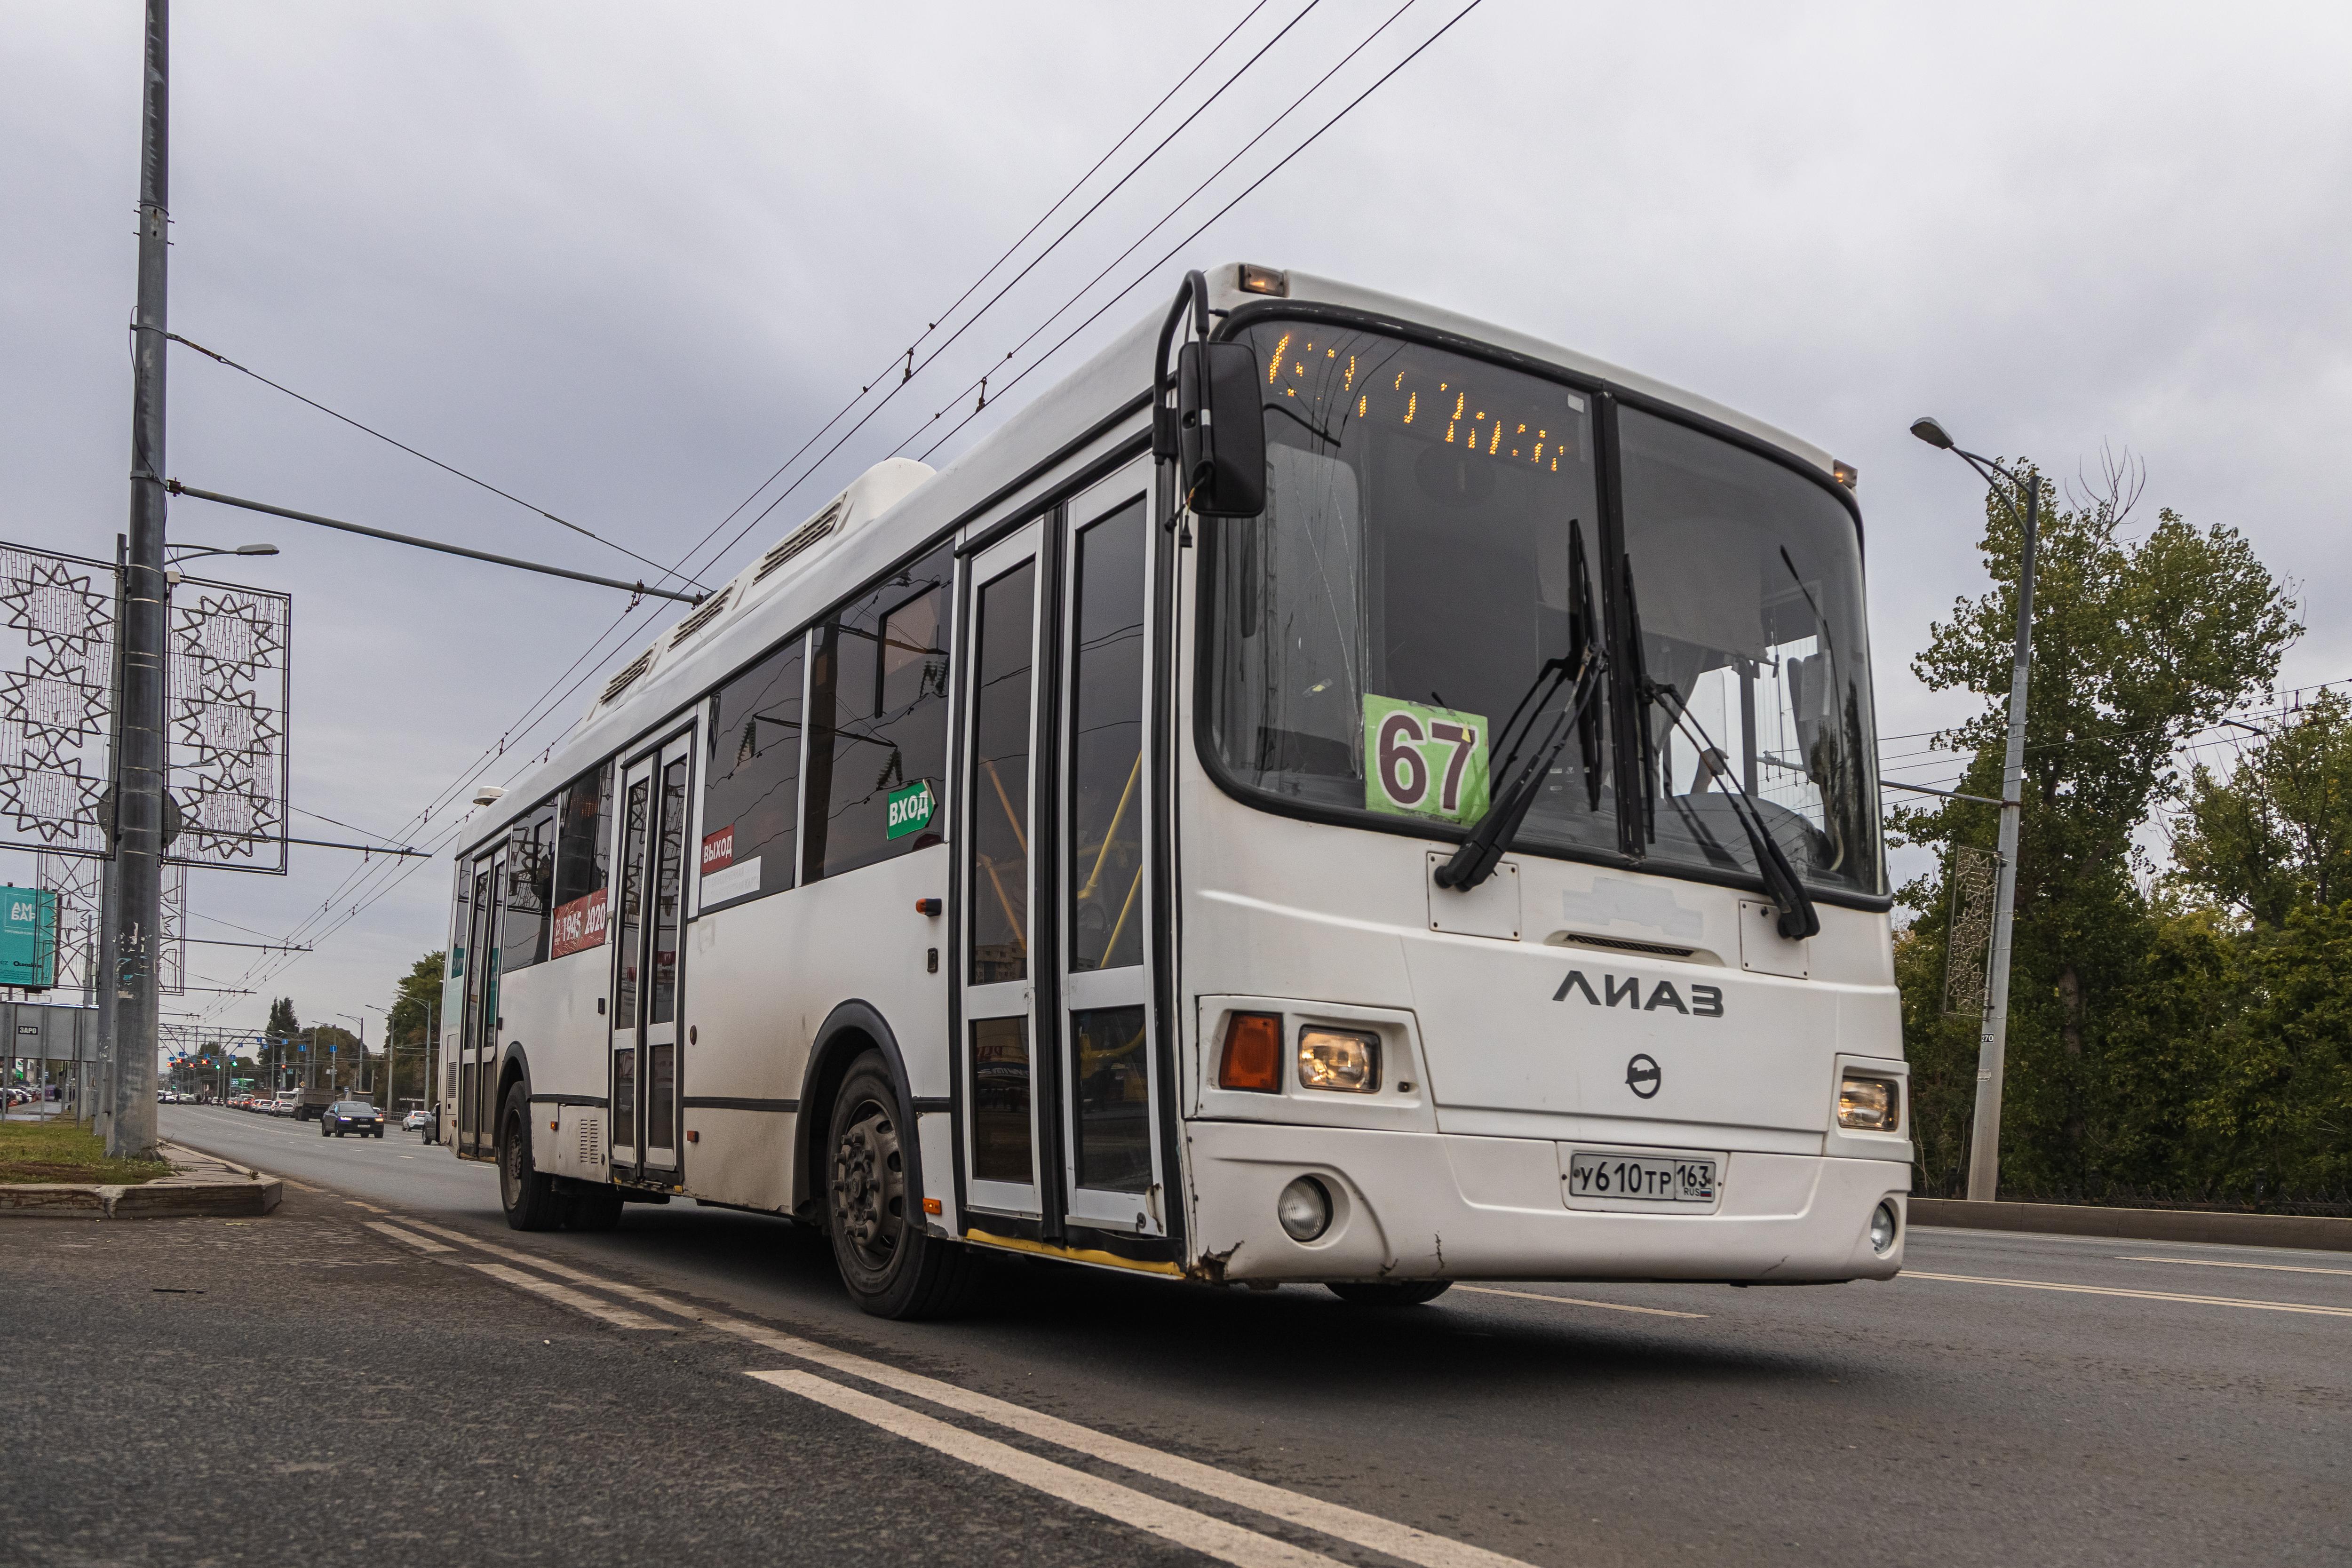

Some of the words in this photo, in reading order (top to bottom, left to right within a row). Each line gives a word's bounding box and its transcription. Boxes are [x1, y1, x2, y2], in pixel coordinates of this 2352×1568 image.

[1376, 710, 1478, 814] 67
[889, 790, 929, 827] ВХОД
[704, 835, 732, 863] ВЫХОД
[11, 910, 36, 921] БАР
[12, 902, 32, 912] АМ
[563, 911, 581, 941] 1945
[584, 902, 606, 934] 2020
[1552, 970, 1724, 1018] ЛИАЗ
[1581, 1162, 1671, 1194] У610ТР
[1677, 1164, 1709, 1187] 163
[1684, 1187, 1700, 1196] RUS
